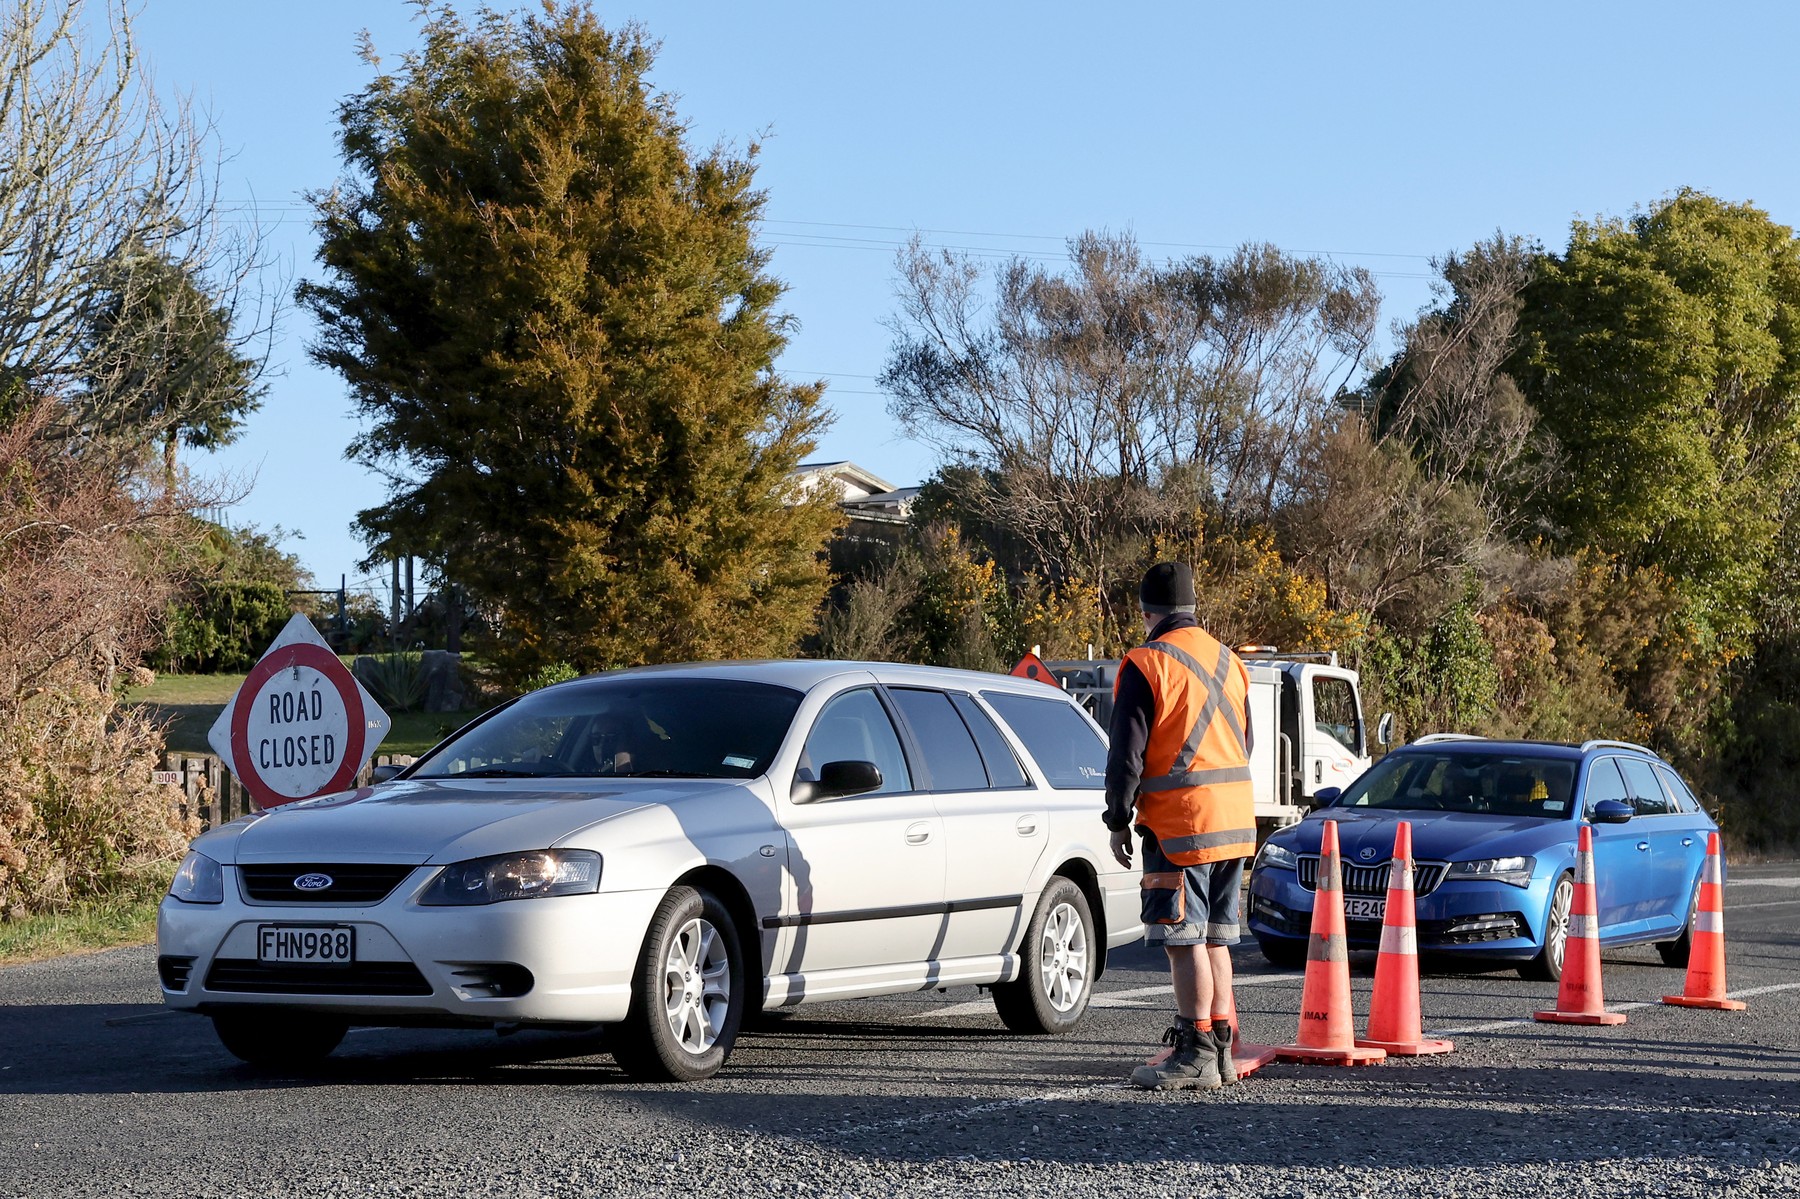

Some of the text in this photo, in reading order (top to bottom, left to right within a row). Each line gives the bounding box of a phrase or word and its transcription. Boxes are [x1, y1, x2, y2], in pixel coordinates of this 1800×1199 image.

[270, 690, 322, 724] ROAD
[260, 734, 335, 769] CLOSED
[301, 876, 325, 888] Ford
[263, 932, 349, 959] FHN988
[1304, 1011, 1328, 1021] IMAX
